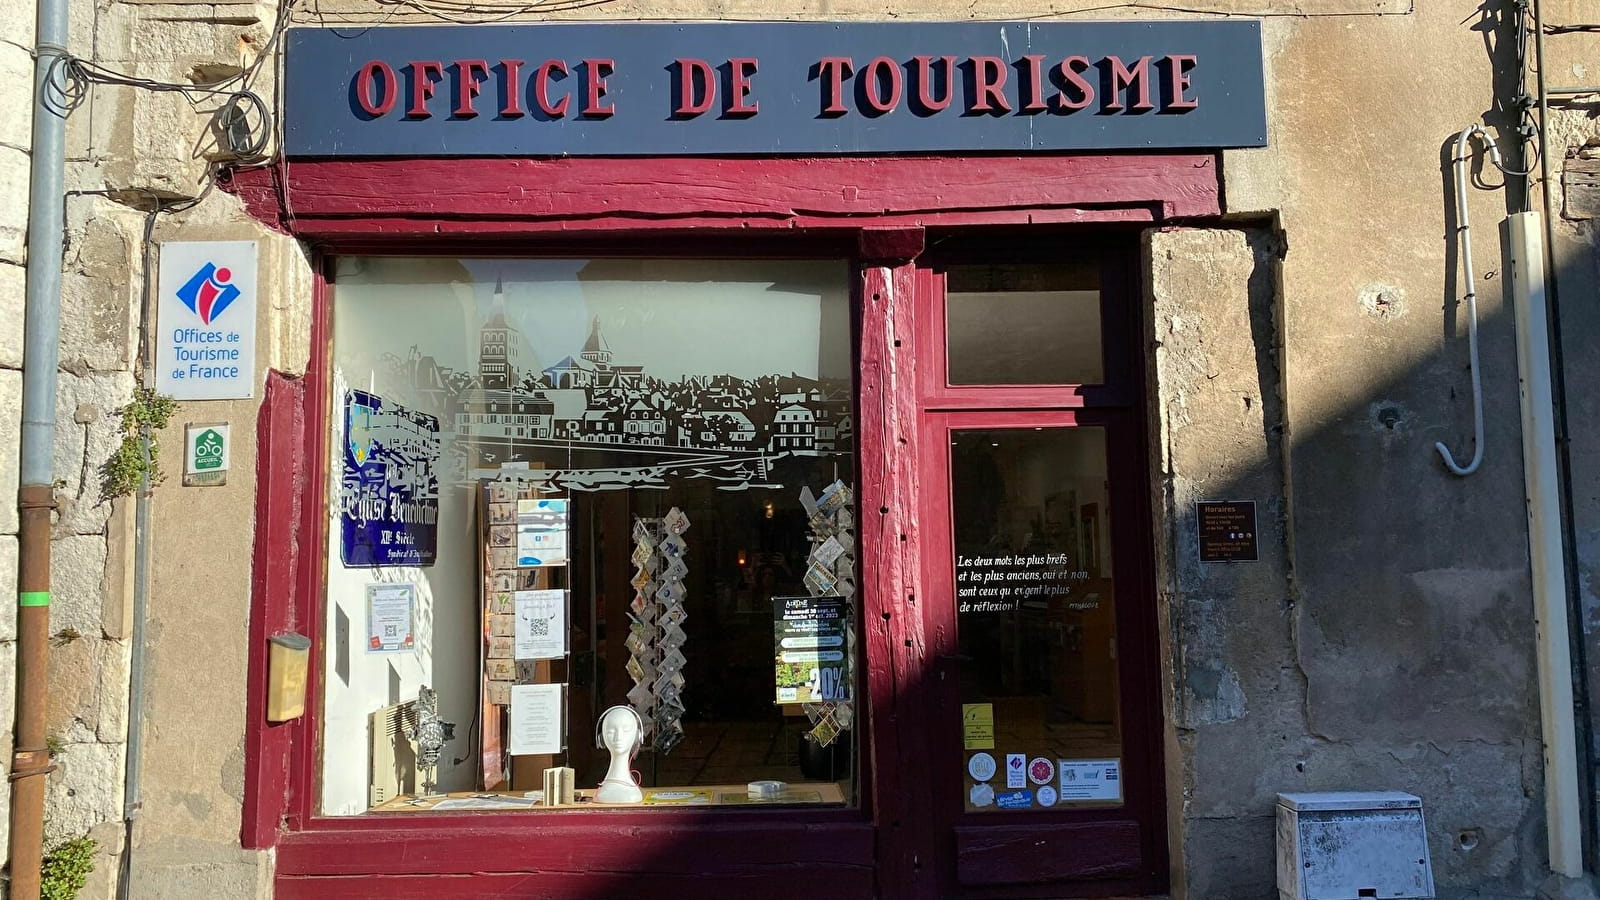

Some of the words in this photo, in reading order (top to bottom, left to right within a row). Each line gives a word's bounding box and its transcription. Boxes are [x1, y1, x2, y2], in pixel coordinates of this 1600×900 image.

[356, 59, 616, 117] OFFICE
[674, 58, 759, 116] DE
[819, 54, 1199, 112] TOURISME
[173, 329, 223, 343] Offices
[226, 332, 240, 343] de
[173, 346, 239, 361] Tourisme
[172, 368, 185, 379] de
[189, 364, 238, 378] France
[957, 555, 973, 567] Les
[973, 556, 993, 566] deux
[994, 555, 1012, 566] mots
[1014, 554, 1025, 565] les
[1026, 554, 1045, 568] plus
[1045, 553, 1068, 565] brefs
[958, 571, 968, 581] et
[970, 571, 982, 581] les
[984, 570, 1004, 585] plus
[1006, 571, 1042, 581] anciens,
[1042, 570, 1056, 579] oui
[1058, 570, 1068, 579] et
[958, 586, 976, 597] sont
[978, 589, 998, 597] ceux
[1043, 585, 1050, 594] le
[1050, 584, 1070, 597] plus
[959, 602, 970, 612] de
[973, 600, 1013, 612] réflexion
[809, 667, 844, 700] 20%
